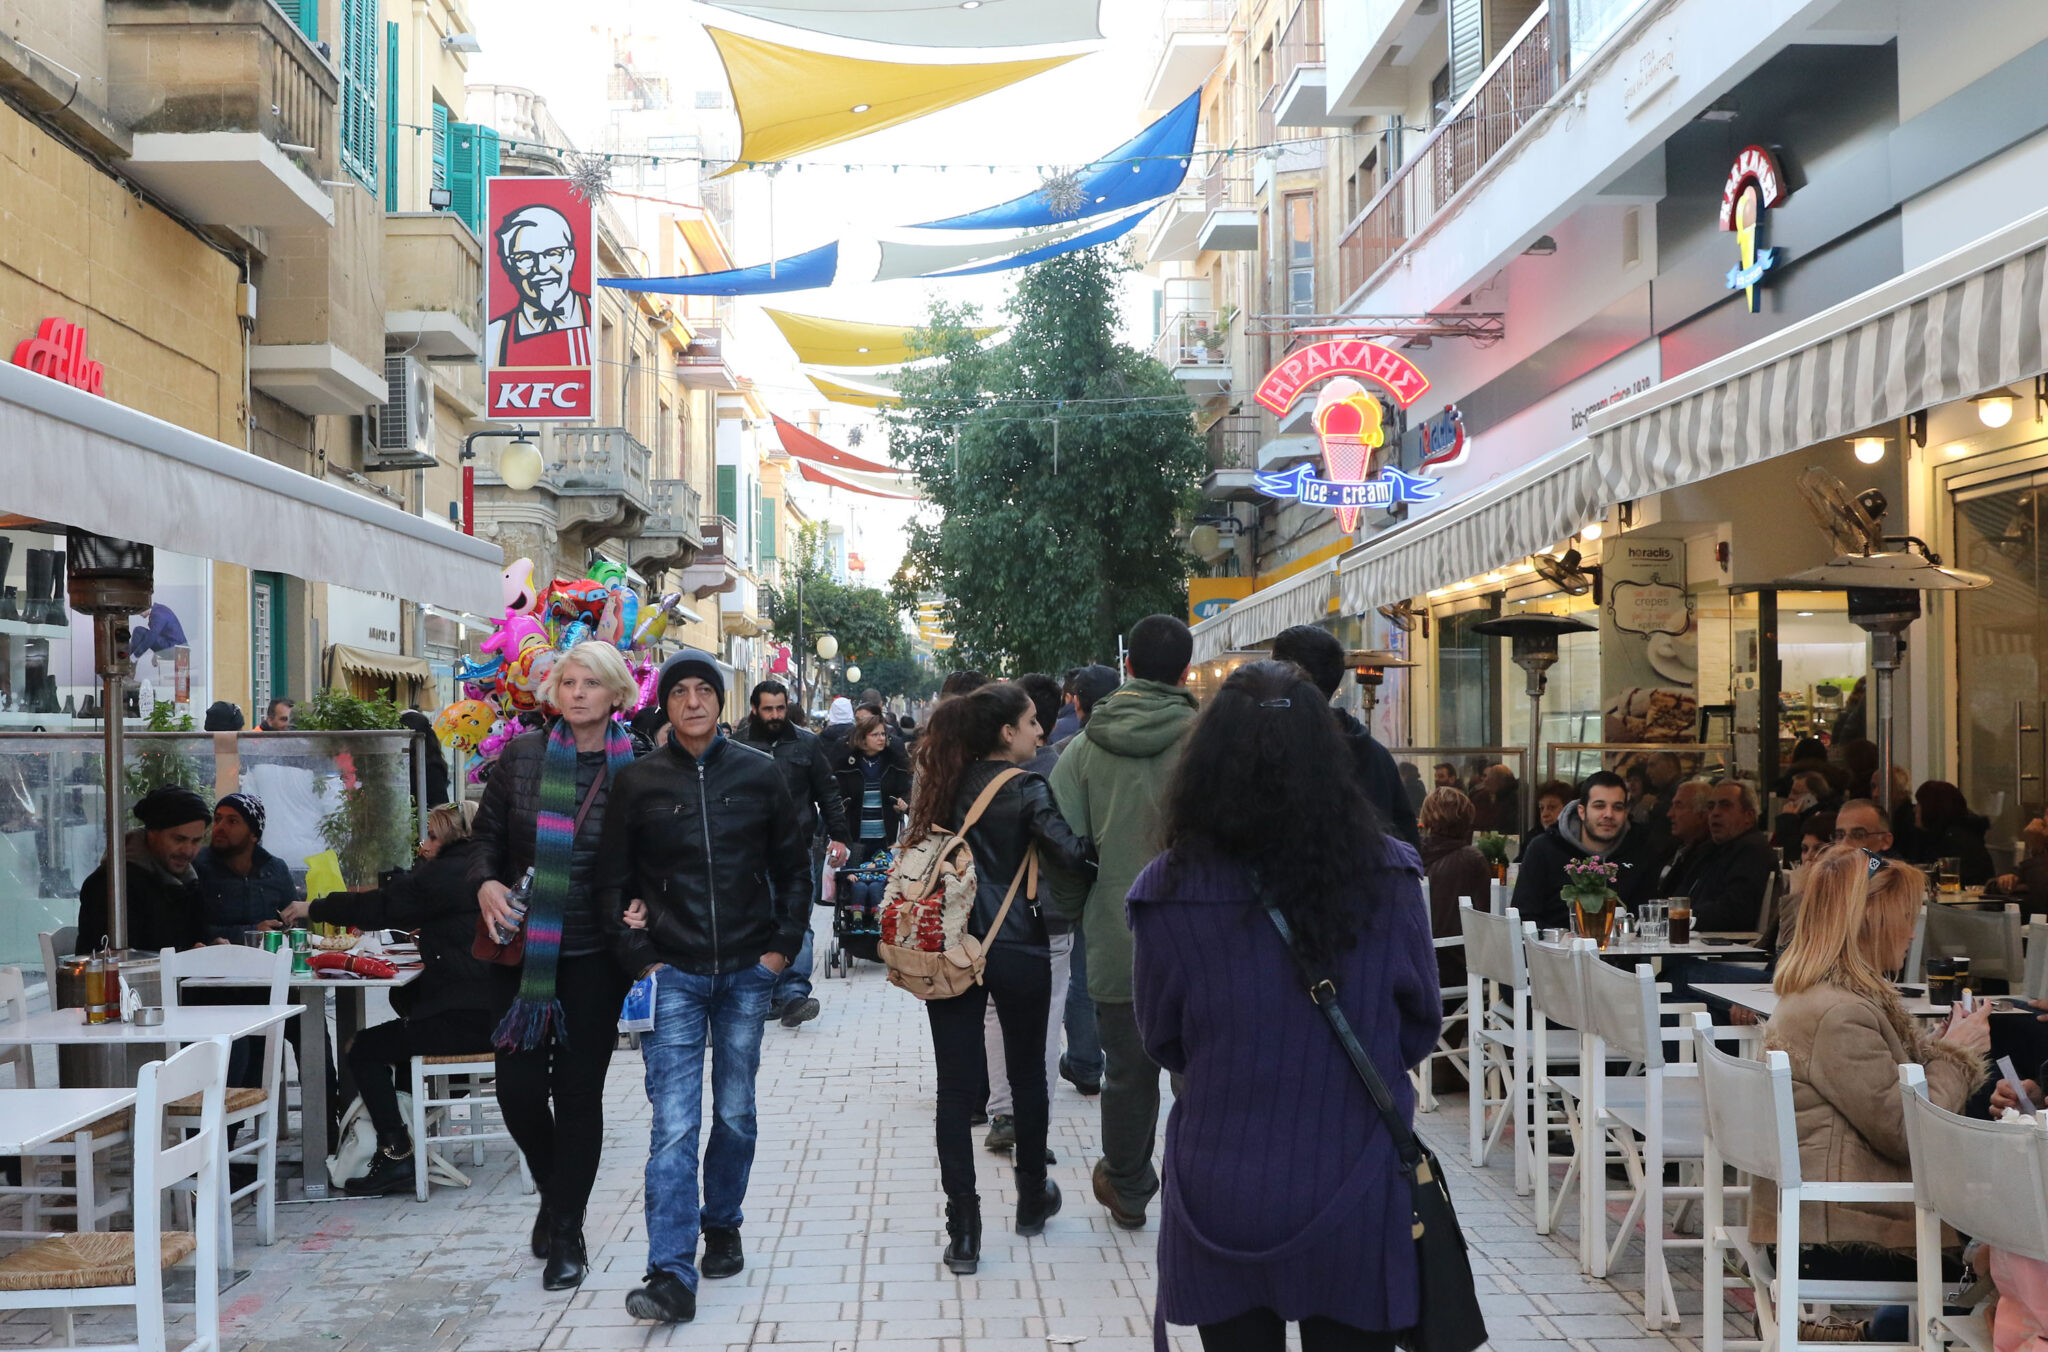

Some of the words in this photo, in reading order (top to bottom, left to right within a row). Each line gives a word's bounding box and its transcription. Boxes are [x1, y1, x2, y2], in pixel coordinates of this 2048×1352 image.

[1264, 341, 1419, 405] ΗΡΑΚΛΗΣ
[495, 382, 580, 408] KFC
[1634, 598, 1669, 608] crepes
